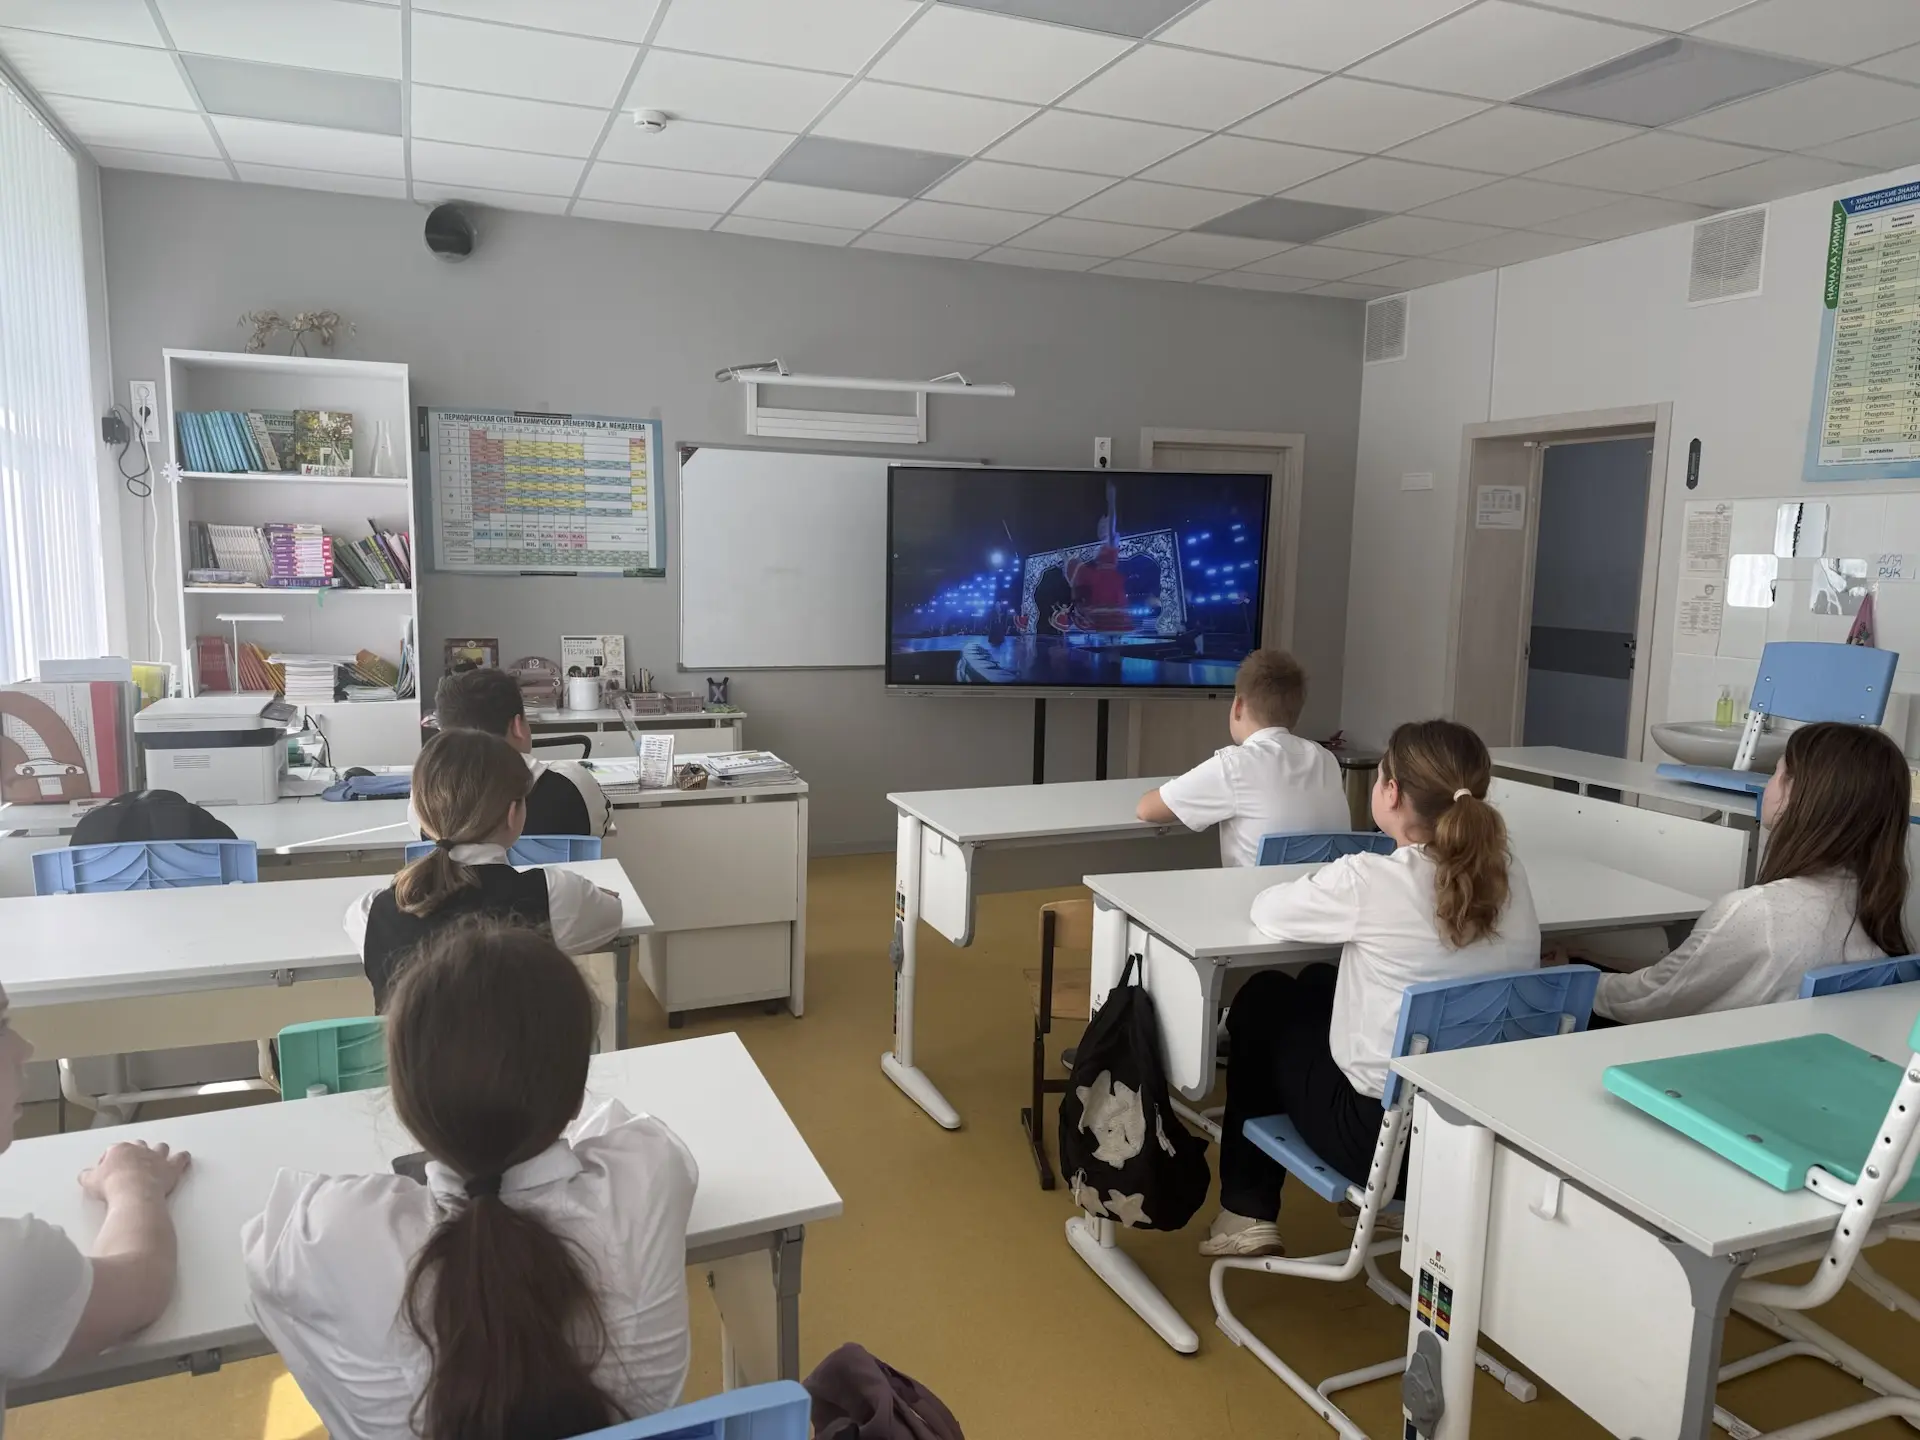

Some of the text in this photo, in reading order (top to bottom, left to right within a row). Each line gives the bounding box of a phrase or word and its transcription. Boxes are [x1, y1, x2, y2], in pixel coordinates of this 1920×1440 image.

[1854, 191, 1920, 211] МАССЫ ВАЖНЕЙШИХ
[1856, 189, 1897, 205] ХИМИЧЕСКИЕ
[1898, 185, 1920, 195] ЗНАКИ
[1831, 213, 1842, 255] ХИМИИ
[1884, 230, 1917, 240] Nitrogenium
[1881, 256, 1917, 267] Hydrogenium
[1826, 256, 1838, 301] НАЧАЛА
[444, 413, 495, 422] ПЕРИОДИЧЕСКАЯ
[495, 416, 522, 424] СИСТЕМА
[522, 417, 561, 426] ХИМИЧЕСКИХ
[562, 419, 596, 428] ЭЛЕМЕНТОВ
[609, 422, 646, 431] МЕНДЕЛЕЕВА
[1876, 553, 1902, 567] ДЛЯ
[1879, 567, 1901, 578] РУК
[528, 658, 540, 669] 12
[549, 668, 556, 676] 2
[552, 677, 561, 687] 3
